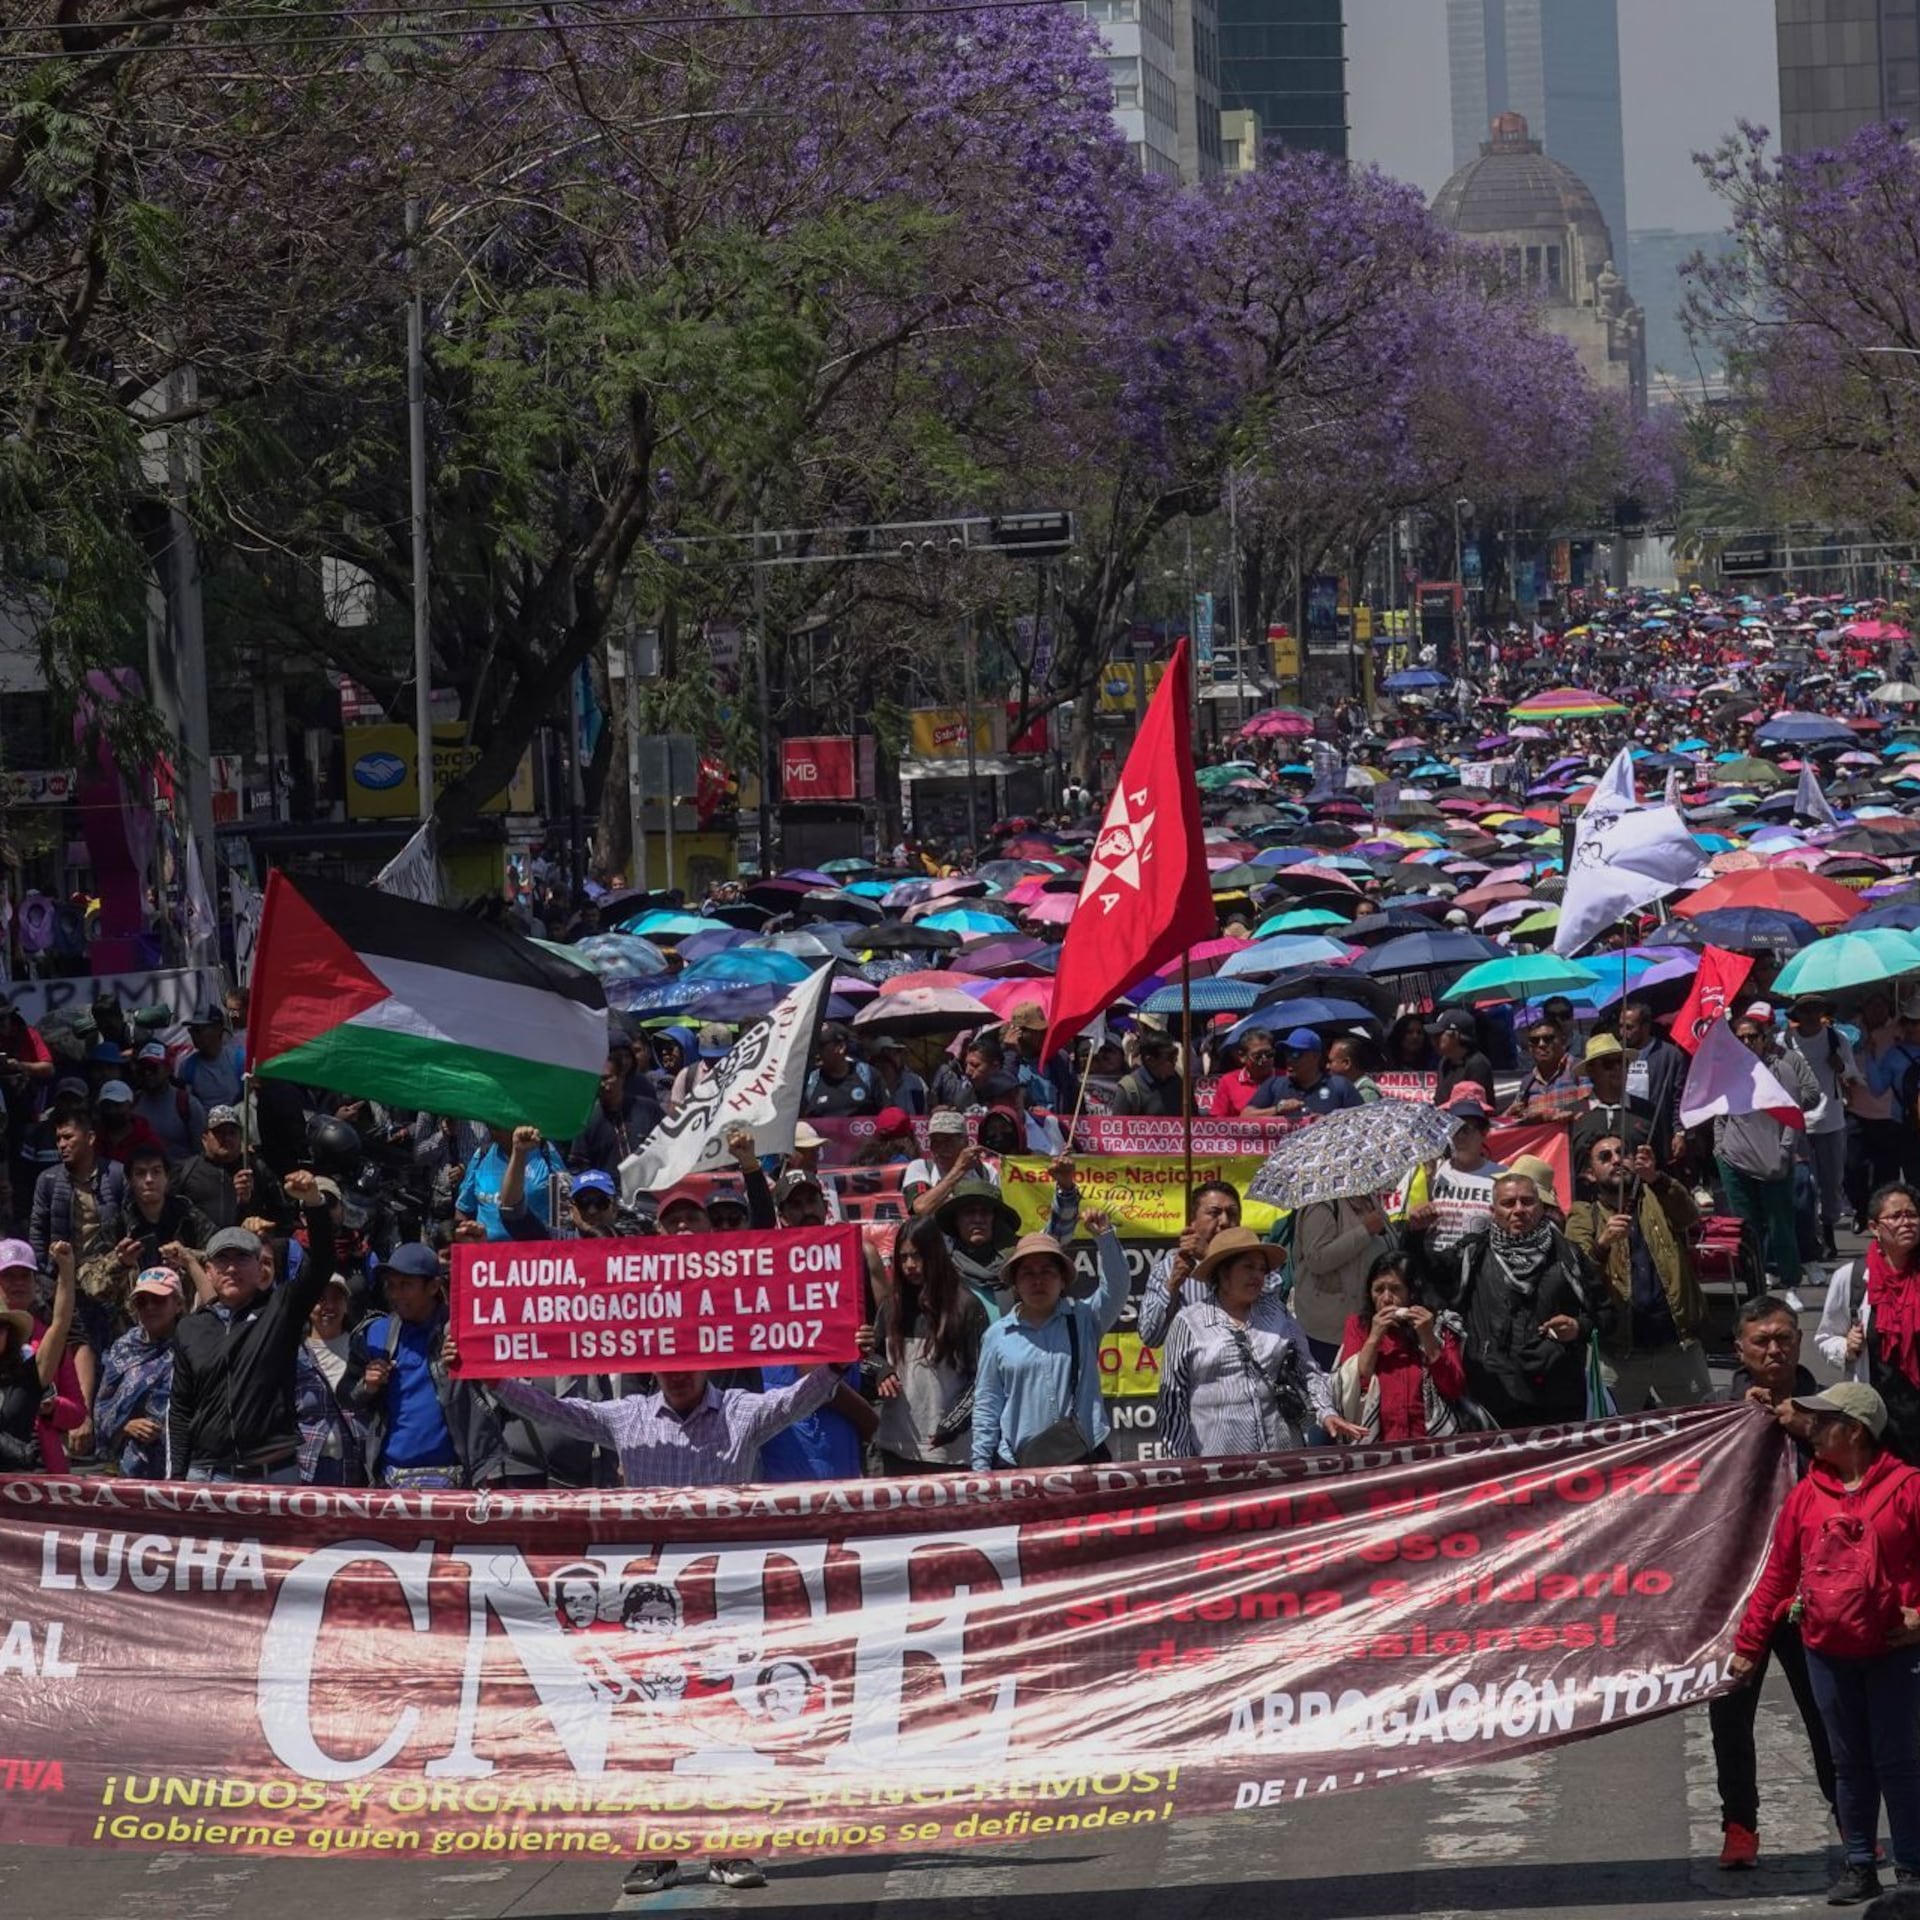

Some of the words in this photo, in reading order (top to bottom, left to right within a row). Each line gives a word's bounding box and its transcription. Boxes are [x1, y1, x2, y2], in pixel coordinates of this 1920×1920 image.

[1101, 1120, 1123, 1135] DE
[1127, 1119, 1260, 1136] TRABAADORES
[471, 1258, 587, 1289] CLAUDIA,
[606, 1248, 774, 1284] MENTISSSTE
[788, 1243, 842, 1273] CON
[472, 1297, 507, 1326] LA
[521, 1284, 682, 1324] ABROGACIÓN
[699, 1289, 715, 1316] A
[735, 1286, 771, 1314] LA
[787, 1281, 841, 1311] LEY
[494, 1333, 548, 1361] DEL
[570, 1327, 677, 1359] ISSSTE
[699, 1325, 735, 1354] DE
[749, 1319, 824, 1351] 2007
[1112, 1405, 1157, 1430] NO
[143, 1487, 456, 1521] NACIONAL
[586, 1470, 1077, 1523] TRABAJADORES
[1096, 1466, 1186, 1494] DE
[1203, 1459, 1288, 1484] LA
[1184, 1490, 1345, 1532] UMA
[39, 1531, 267, 1592] LUCHA
[102, 1775, 327, 1812] ¡UNIDOS
[343, 1781, 373, 1813] Y
[93, 1814, 296, 1846] ¡Gobierne
[307, 1822, 420, 1851] quien
[431, 1823, 622, 1855] gobierne,
[635, 1824, 692, 1852] los
[703, 1820, 887, 1851] derechos
[899, 1820, 941, 1843] se
[952, 1801, 1175, 1839] defienden!
